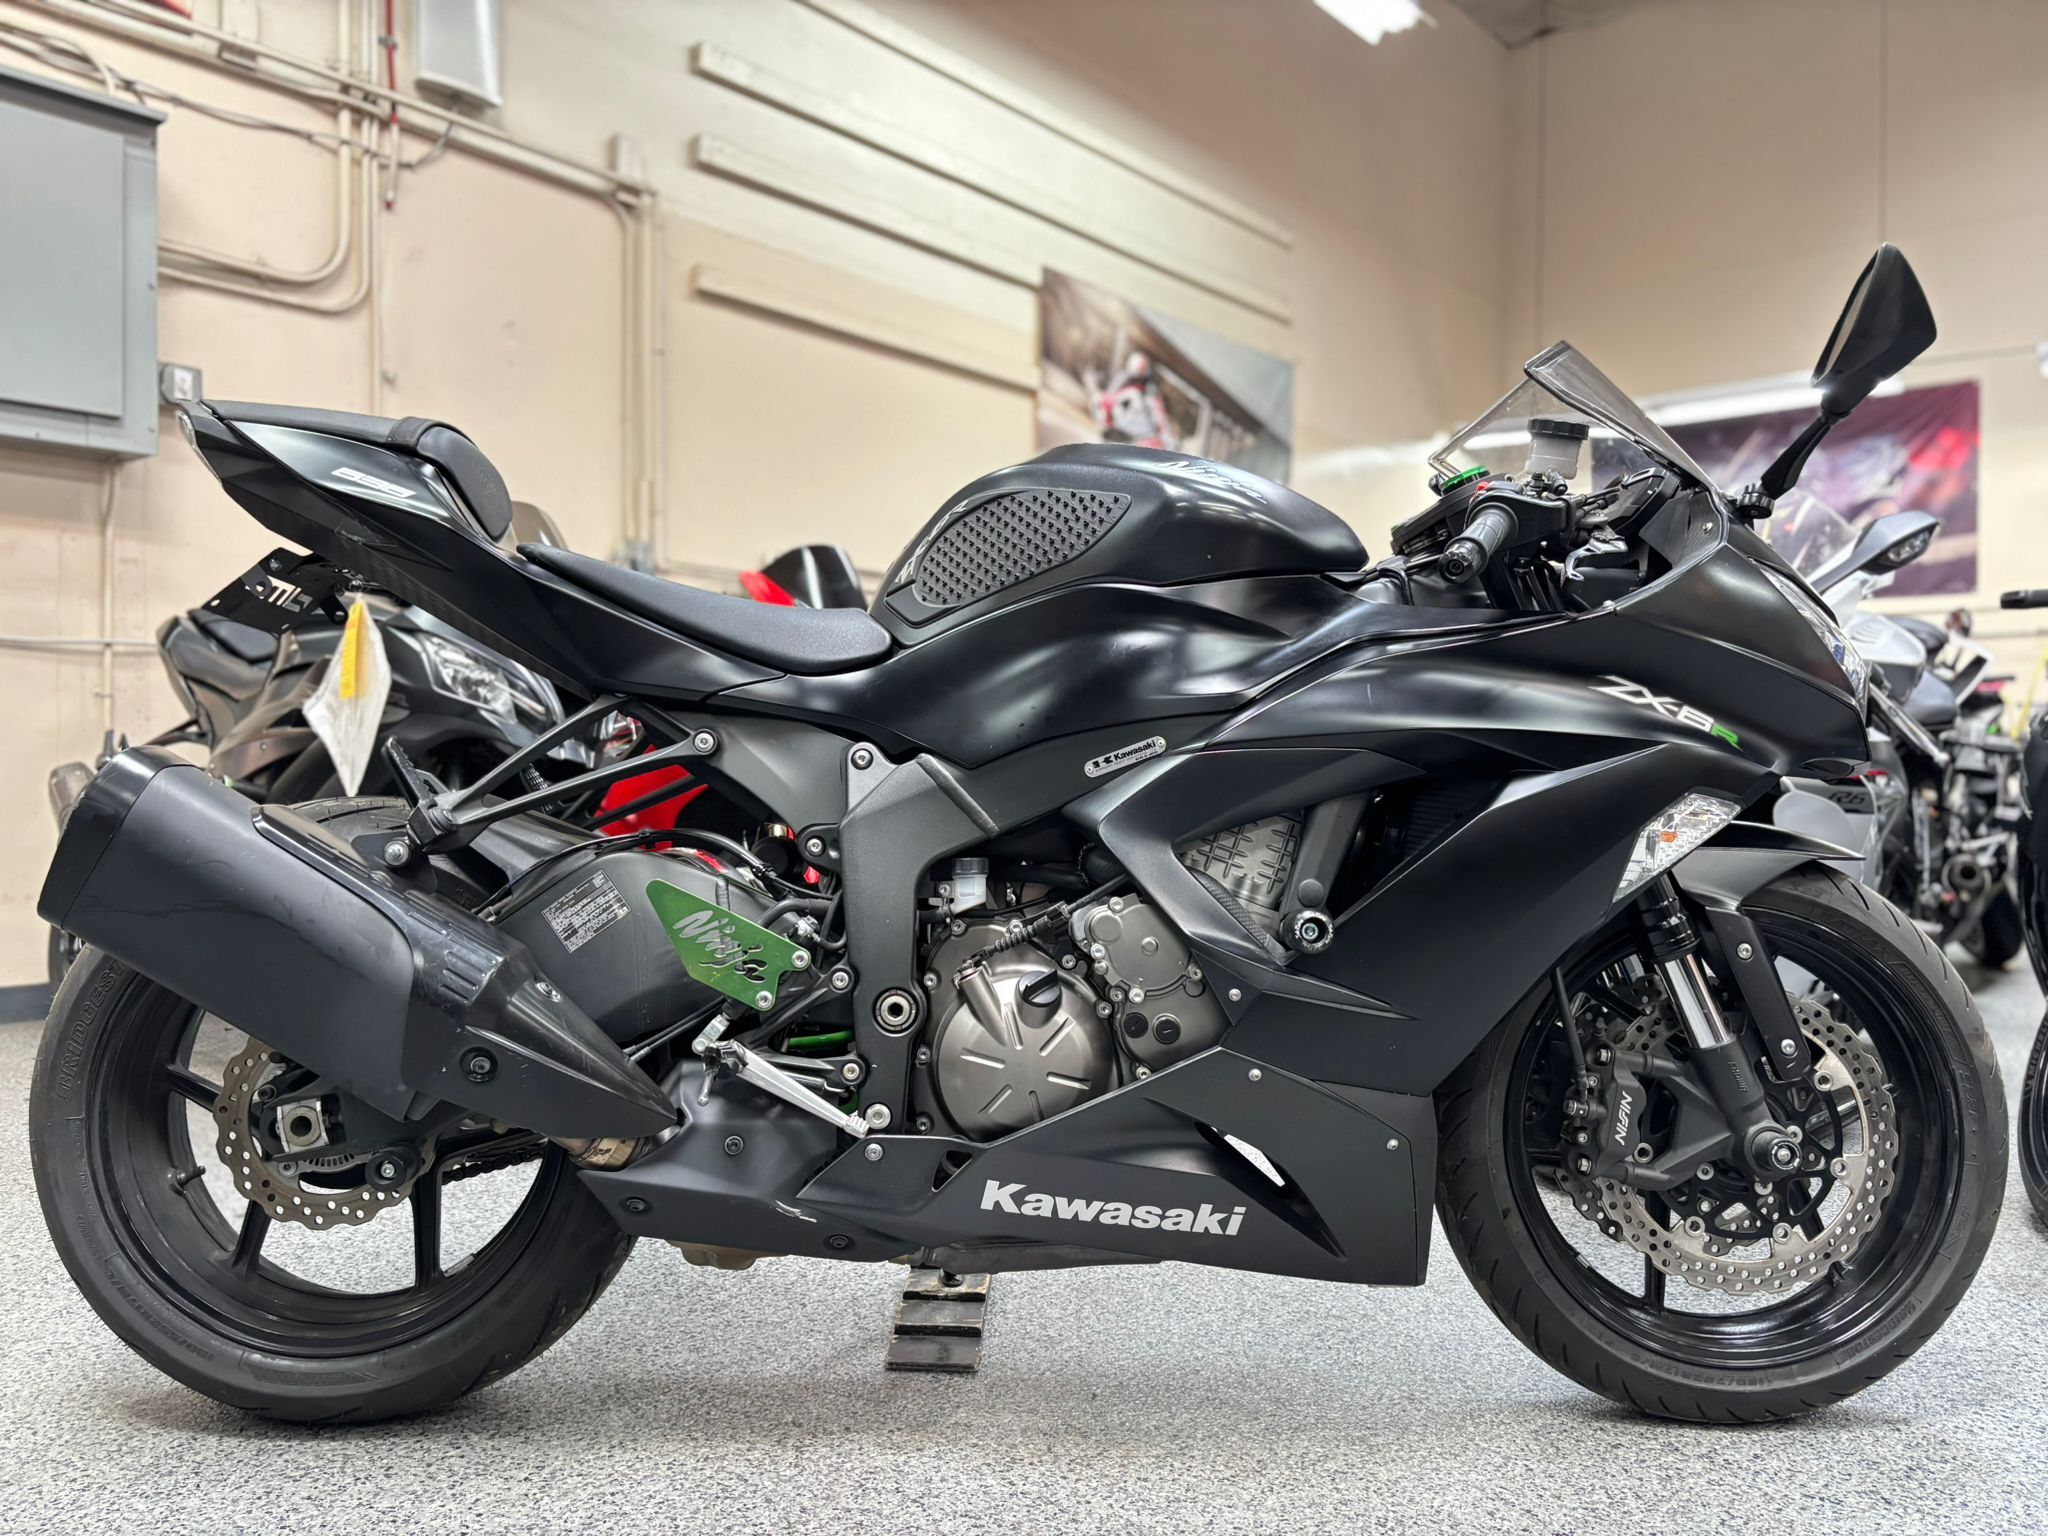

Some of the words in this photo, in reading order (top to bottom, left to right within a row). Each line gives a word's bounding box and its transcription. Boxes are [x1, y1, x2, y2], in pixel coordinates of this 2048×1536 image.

[331, 466, 417, 499] 636
[1587, 674, 1745, 753] ZX-6R
[1113, 740, 1157, 761] Kawasaki
[672, 909, 769, 984] Ninja
[1614, 1090, 1633, 1146] NISSIN
[979, 1179, 1247, 1236] Kawasaki
